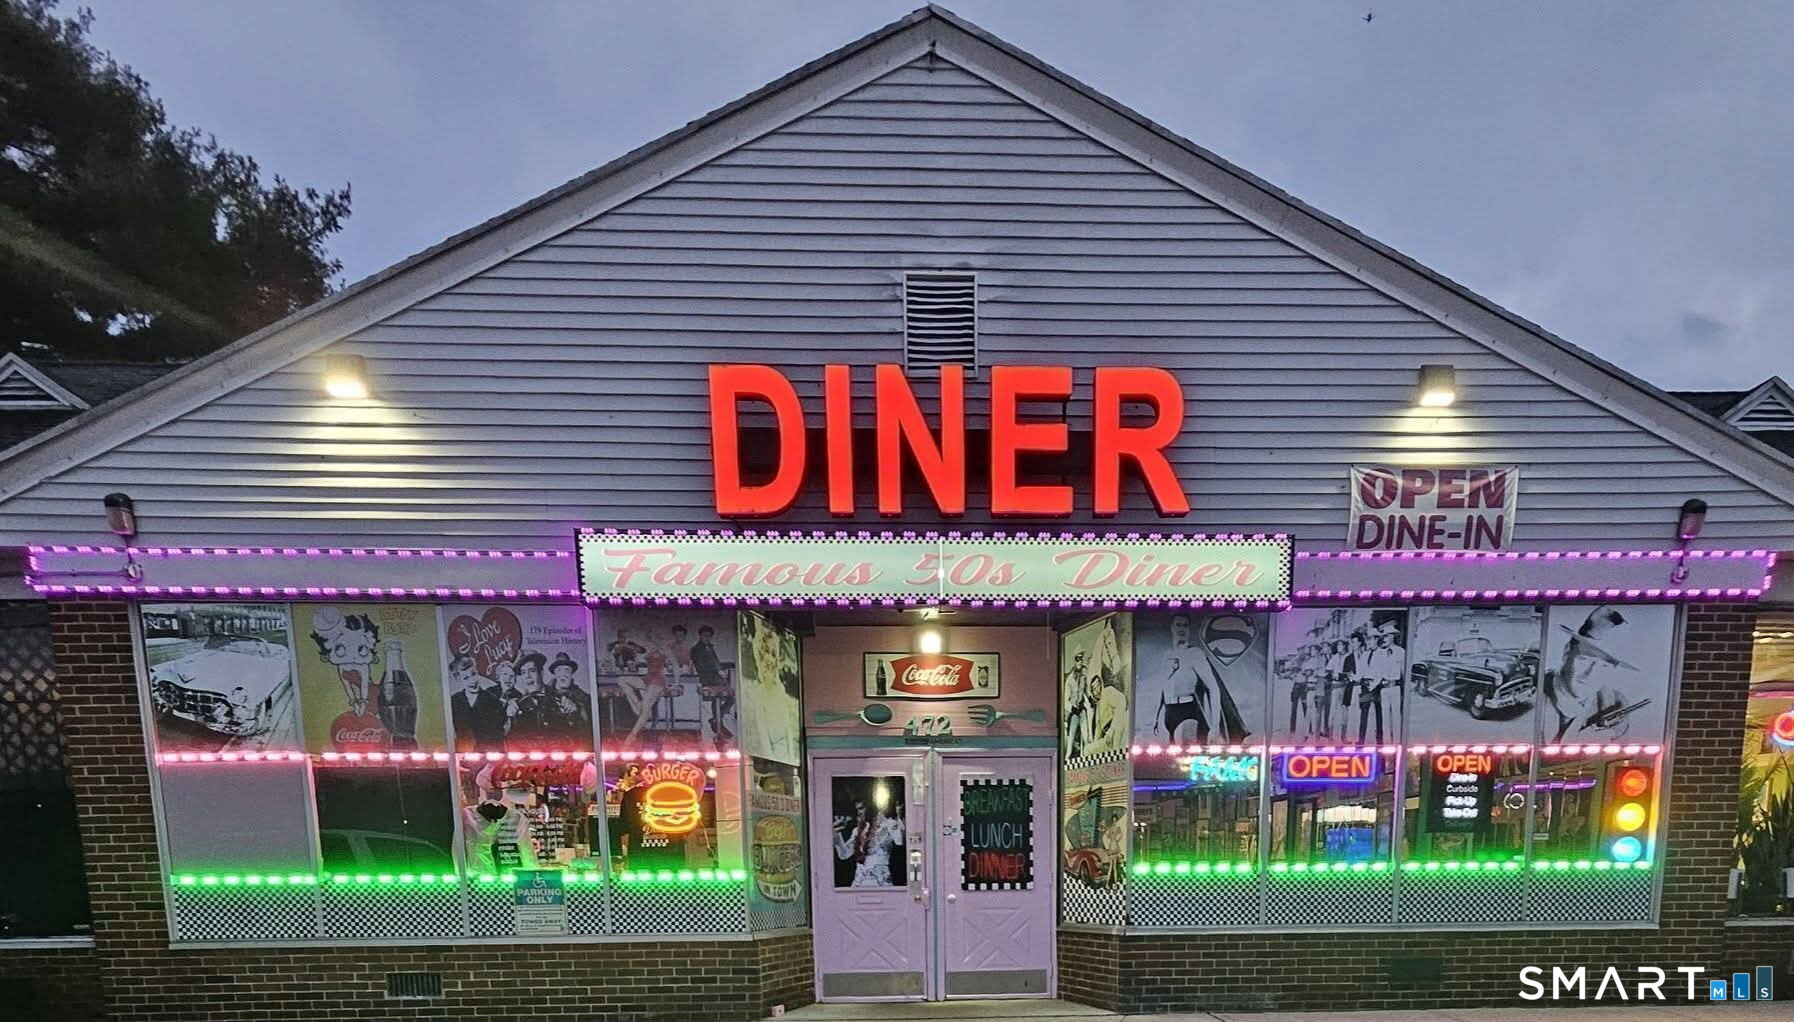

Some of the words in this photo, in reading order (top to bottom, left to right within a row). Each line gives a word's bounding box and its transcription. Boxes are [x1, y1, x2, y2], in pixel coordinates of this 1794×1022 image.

[709, 363, 1190, 518] DINER
[1361, 468, 1507, 509] OPEN
[1356, 514, 1504, 549] DINE-IN
[604, 547, 884, 589] Famous
[904, 552, 1026, 586] 50s
[1053, 547, 1264, 588] Diner
[472, 620, 501, 654] Love
[484, 634, 514, 675] Lucy
[902, 663, 961, 687] Coca-Cola
[904, 714, 953, 737] 472
[641, 763, 701, 786] BURGER
[1289, 755, 1371, 778] OPEN
[1436, 755, 1492, 774] OPEN
[964, 786, 1028, 816] BREAKFAST
[1446, 784, 1479, 793] Curbside
[971, 823, 1023, 849] LUNCH
[968, 851, 1026, 880] DINNER
[516, 888, 562, 897] PARKING
[526, 895, 553, 904] ONLY
[772, 883, 797, 897] TOWN
